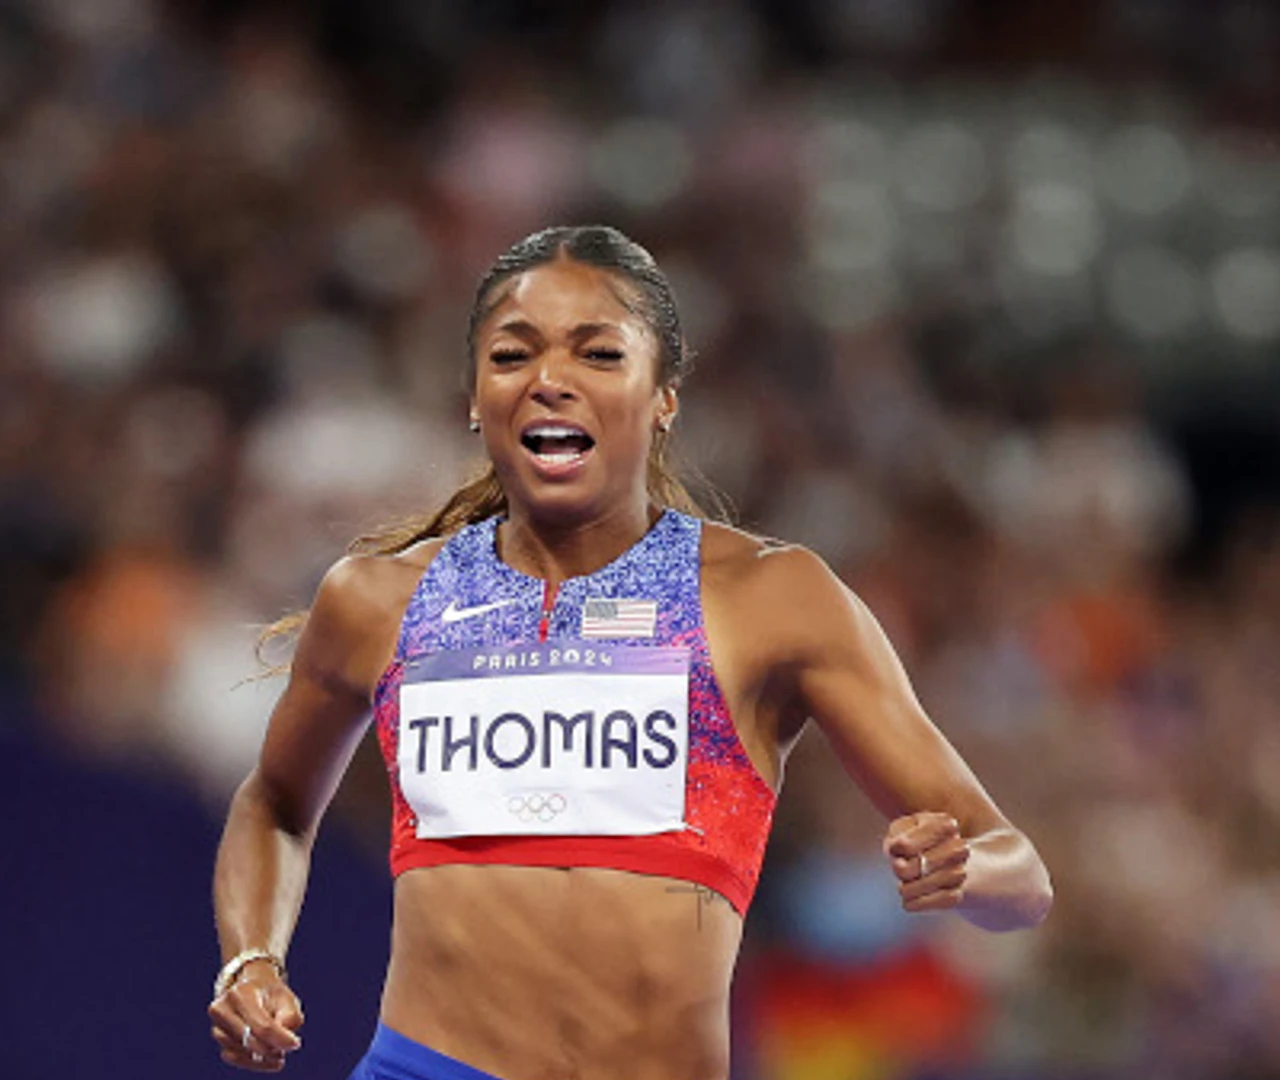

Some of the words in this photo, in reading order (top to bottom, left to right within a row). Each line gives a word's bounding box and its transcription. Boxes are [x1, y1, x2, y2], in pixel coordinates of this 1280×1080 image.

[473, 651, 541, 670] PARIS
[549, 648, 612, 667] 2024
[409, 709, 678, 773] THOMAS
